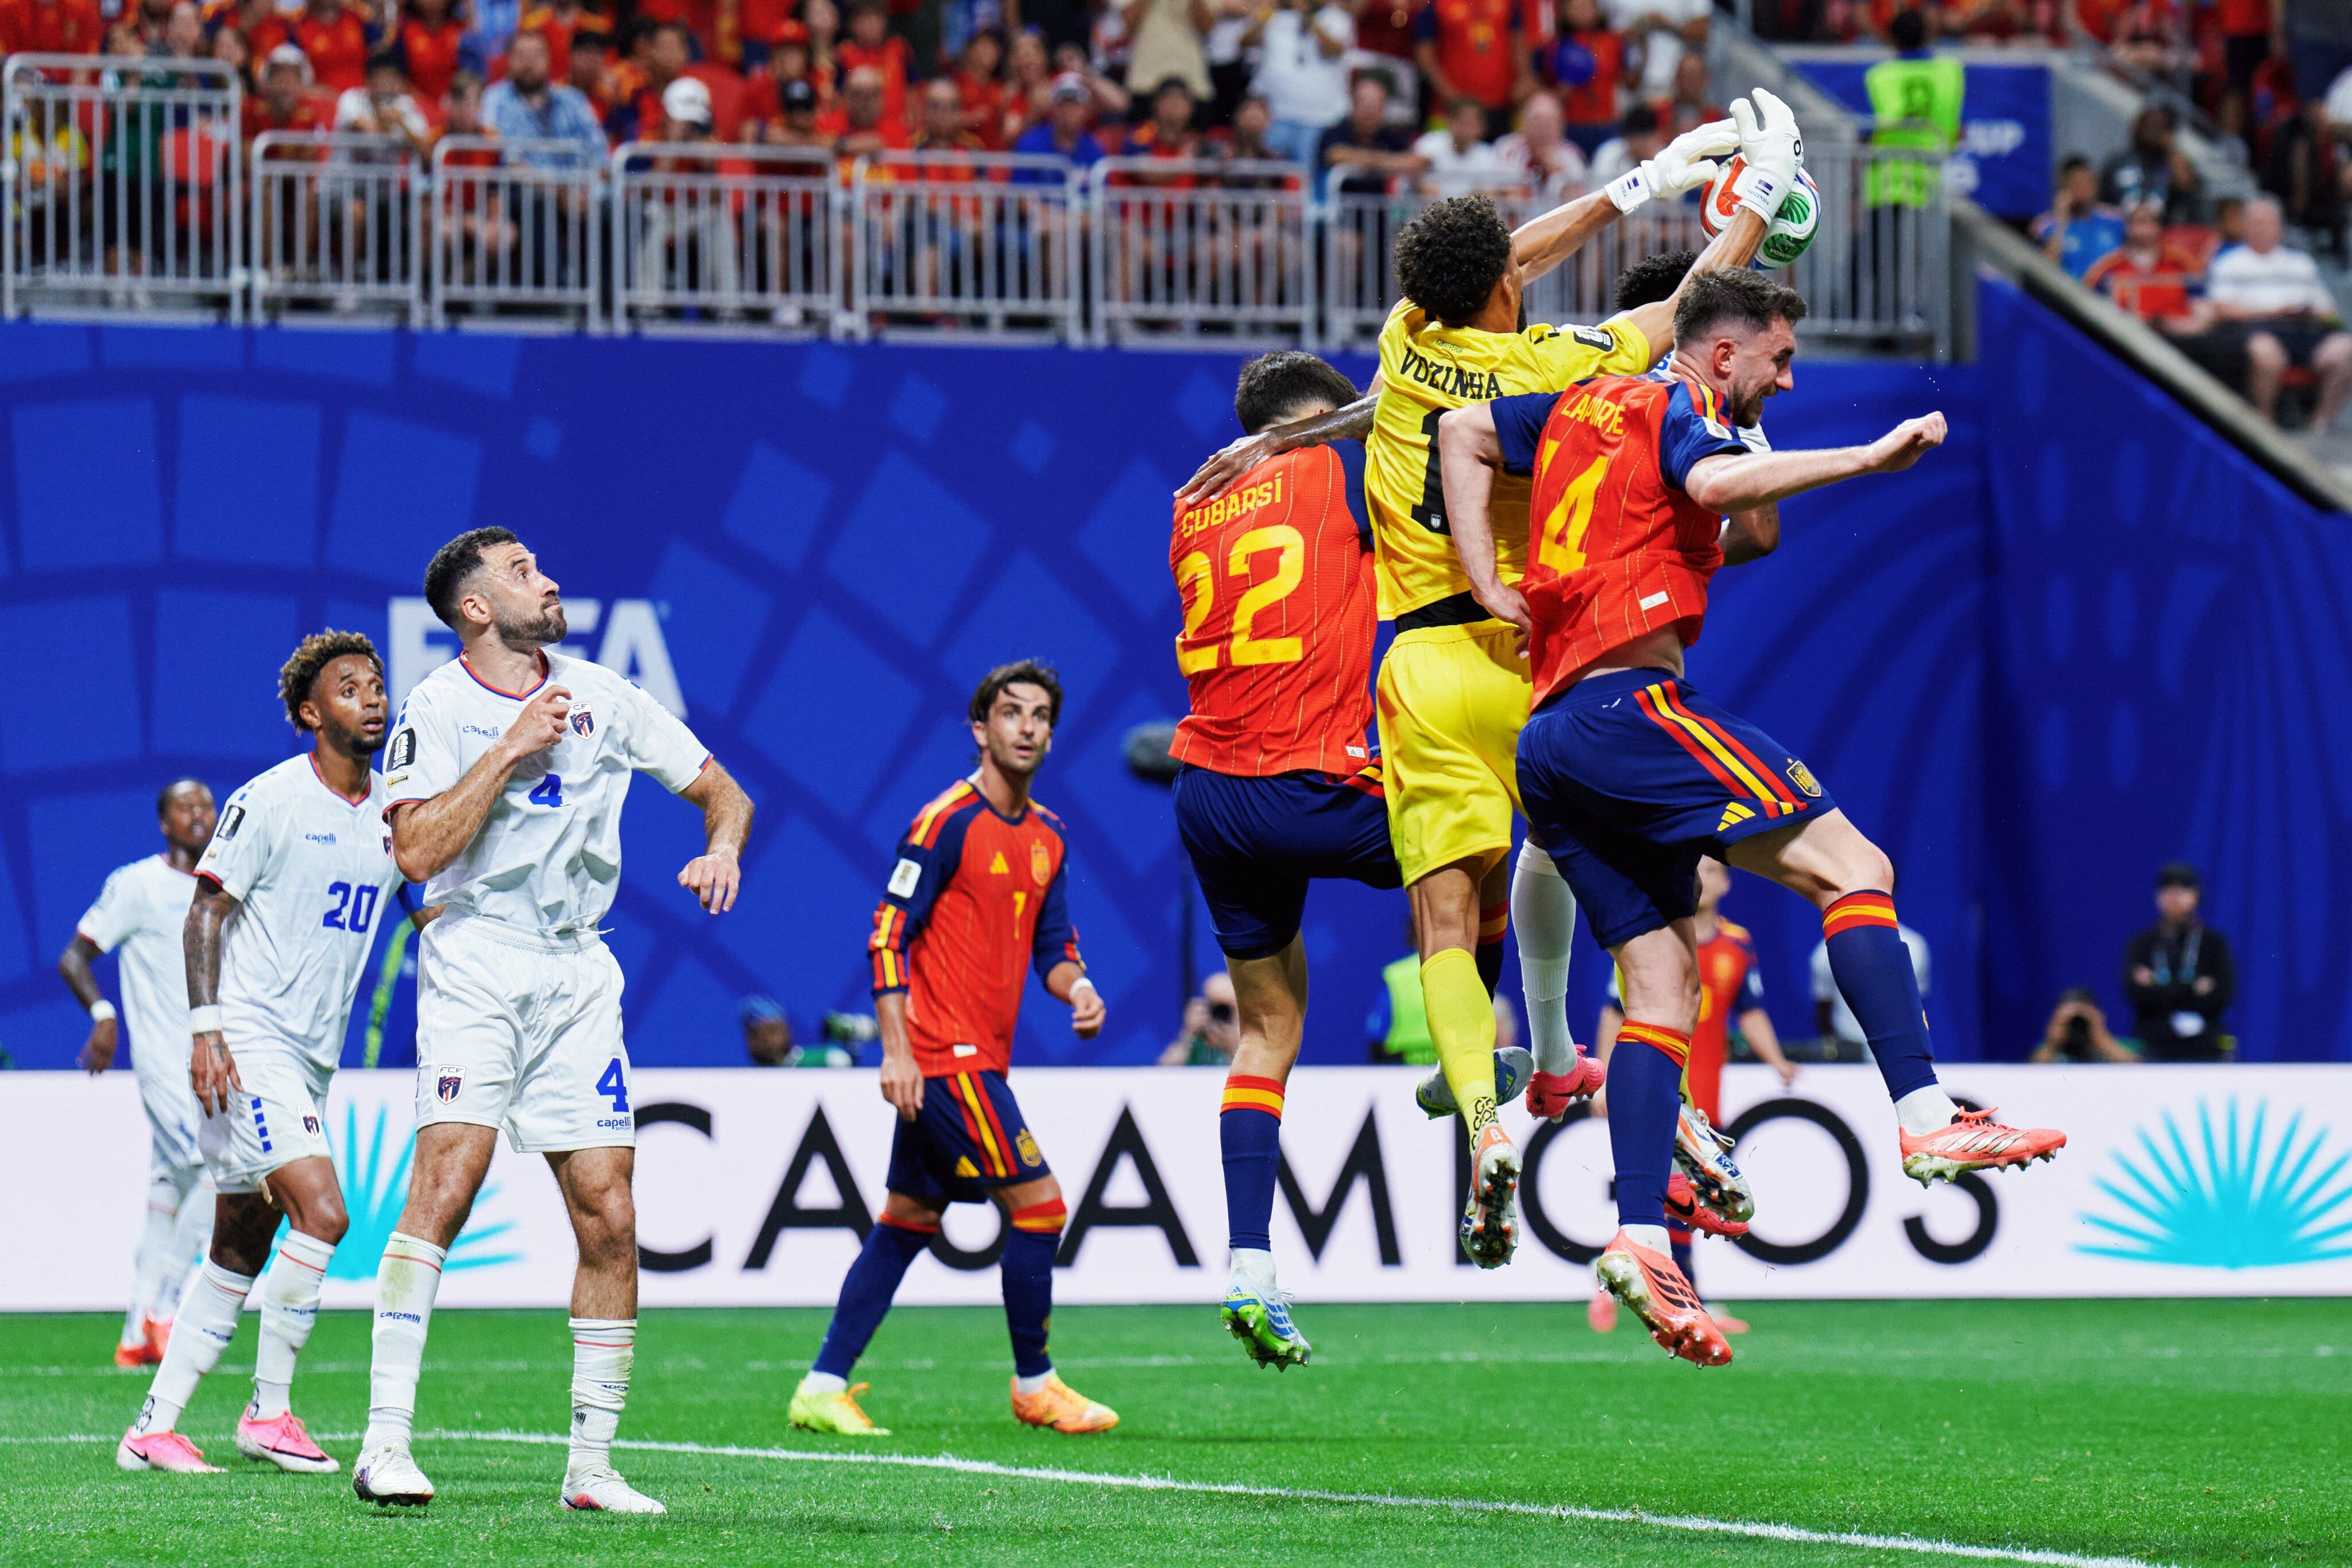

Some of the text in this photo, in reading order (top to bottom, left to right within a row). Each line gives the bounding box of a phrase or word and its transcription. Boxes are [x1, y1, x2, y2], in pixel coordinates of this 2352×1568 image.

[1400, 347, 1503, 400] VOZINHA
[1181, 471, 1283, 538] CUBARSÍ
[1175, 524, 1304, 679] 22
[528, 773, 563, 808] 4
[305, 833, 336, 844] capelli
[322, 881, 380, 934] 20
[595, 1058, 629, 1113] 4
[597, 1116, 631, 1129] capelli
[380, 1311, 421, 1323] capelli
